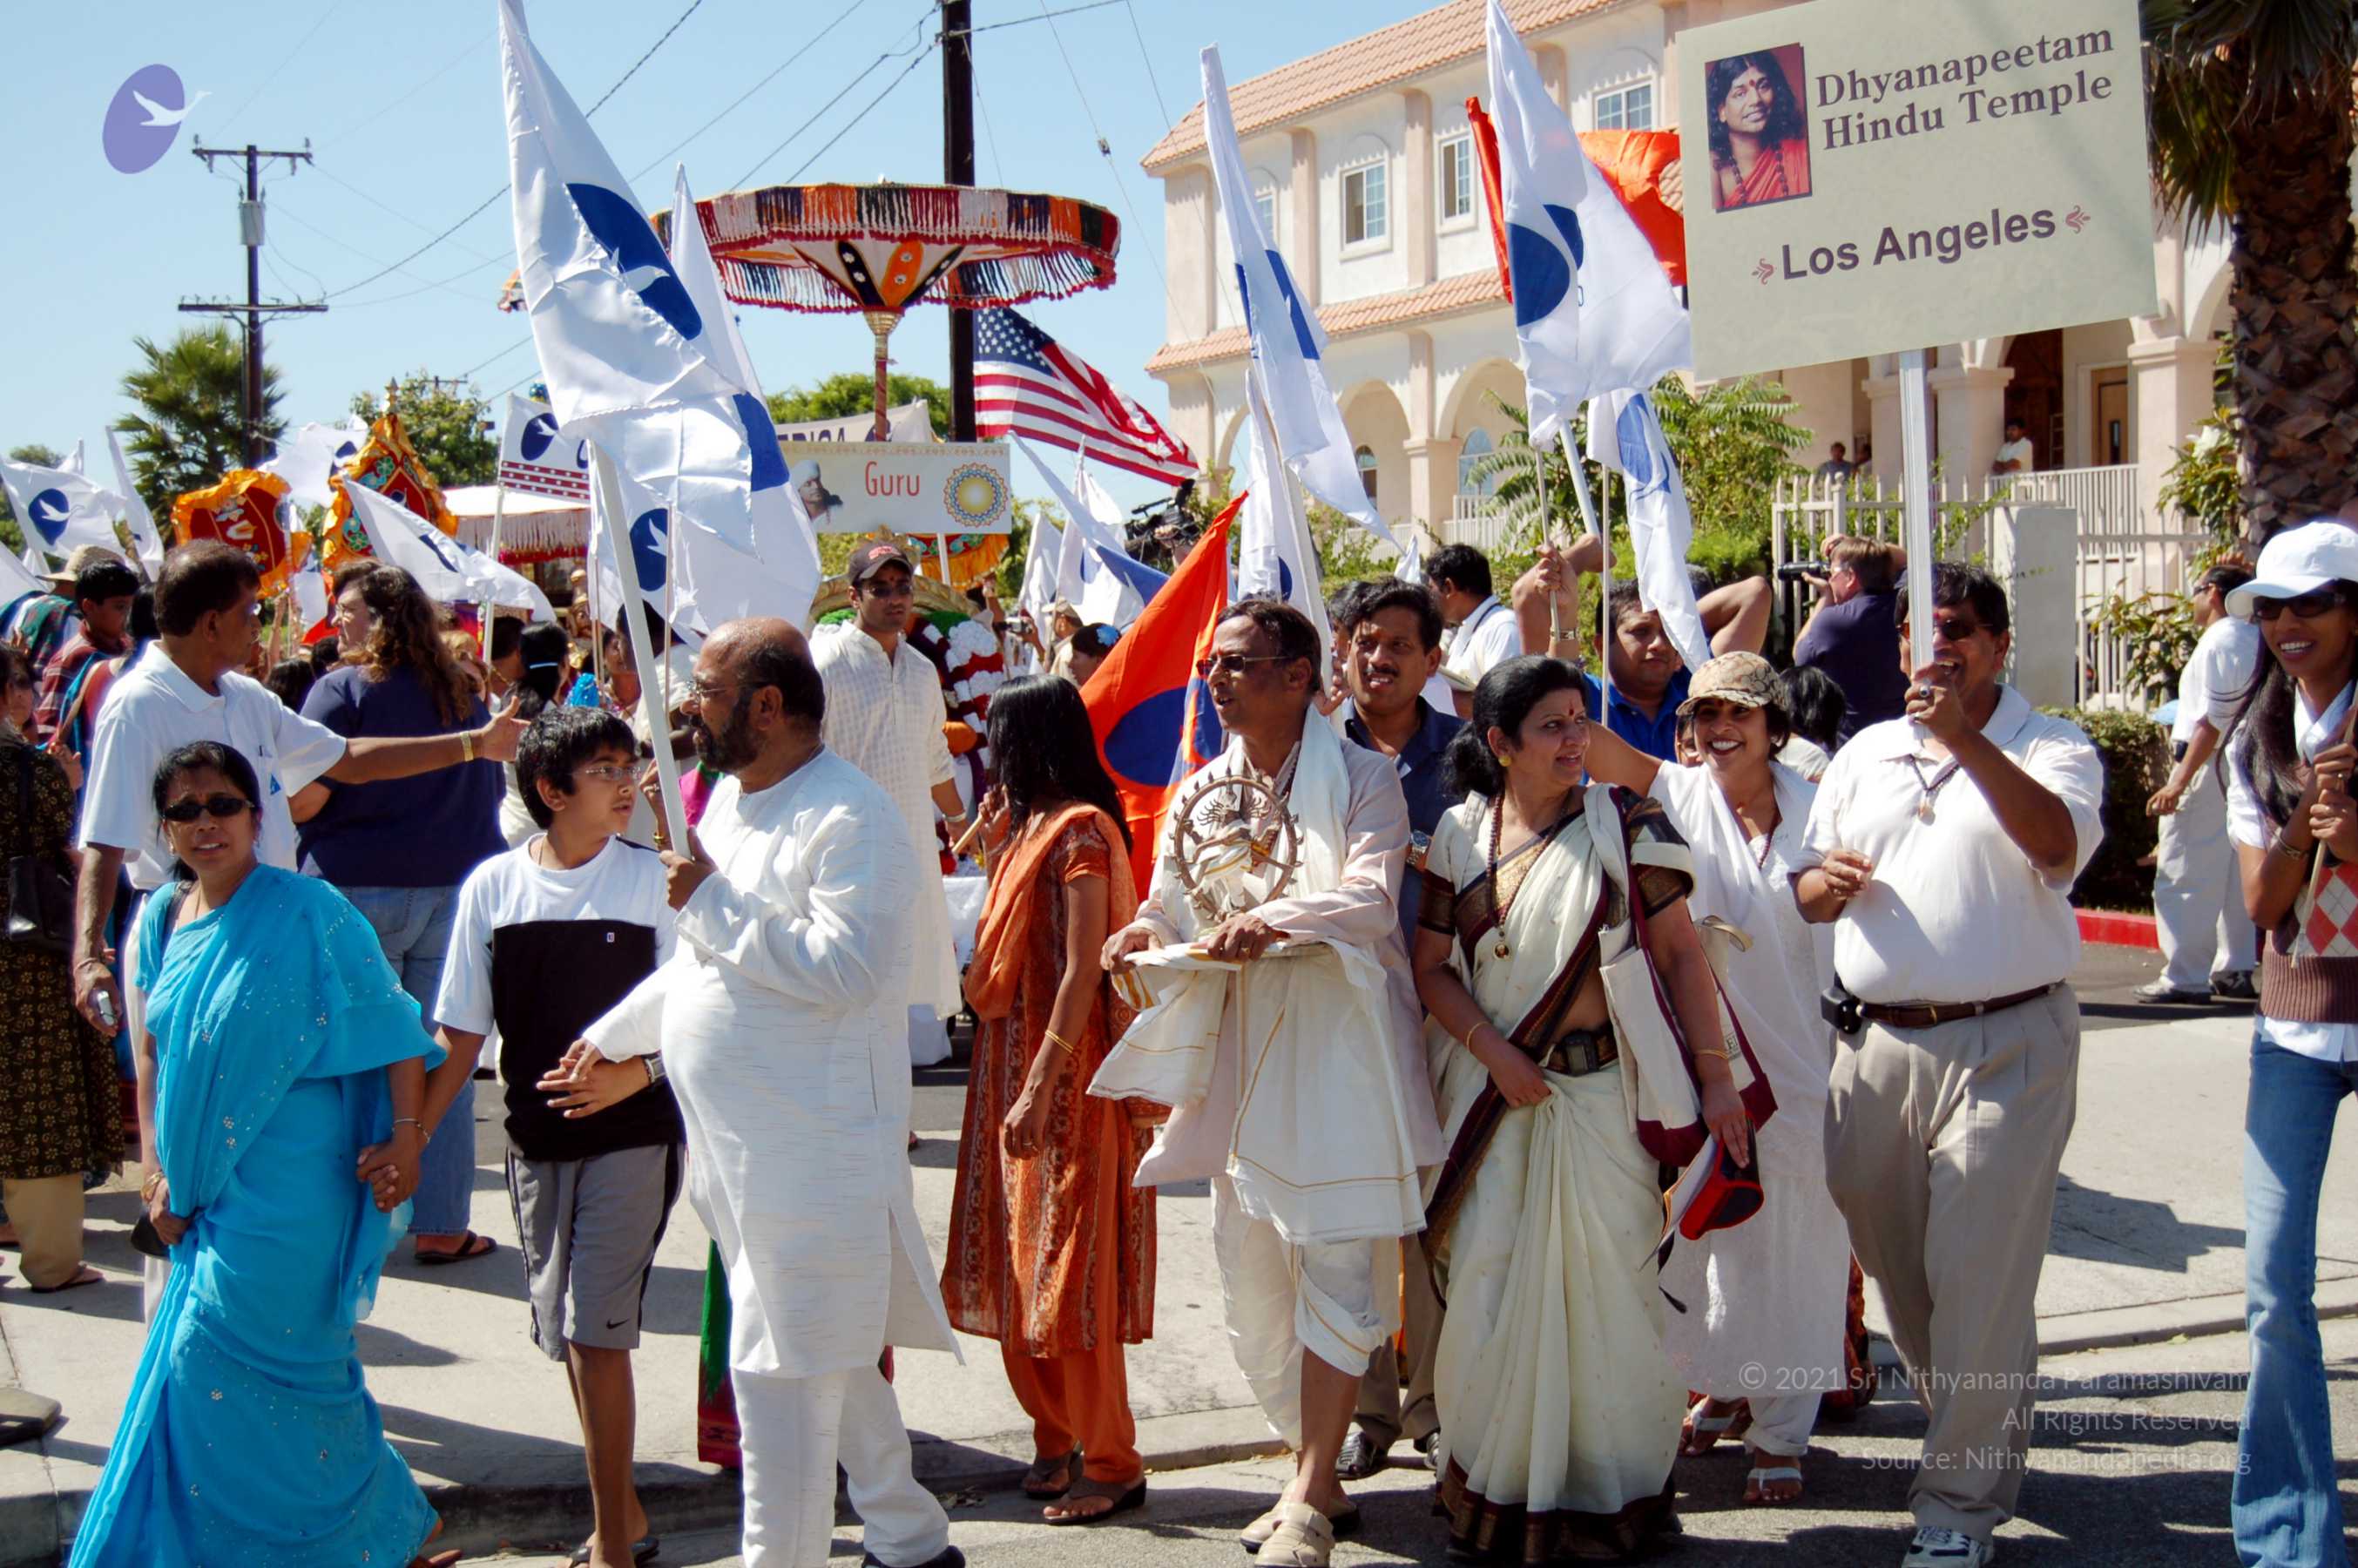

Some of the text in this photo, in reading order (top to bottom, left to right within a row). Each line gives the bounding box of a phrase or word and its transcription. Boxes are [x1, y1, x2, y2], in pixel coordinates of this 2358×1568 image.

[1815, 28, 2114, 107] Dhyanapeetam
[1822, 70, 2112, 150] Hindu Temple
[1782, 208, 2056, 280] Los Angeles
[865, 461, 921, 497] Guru
